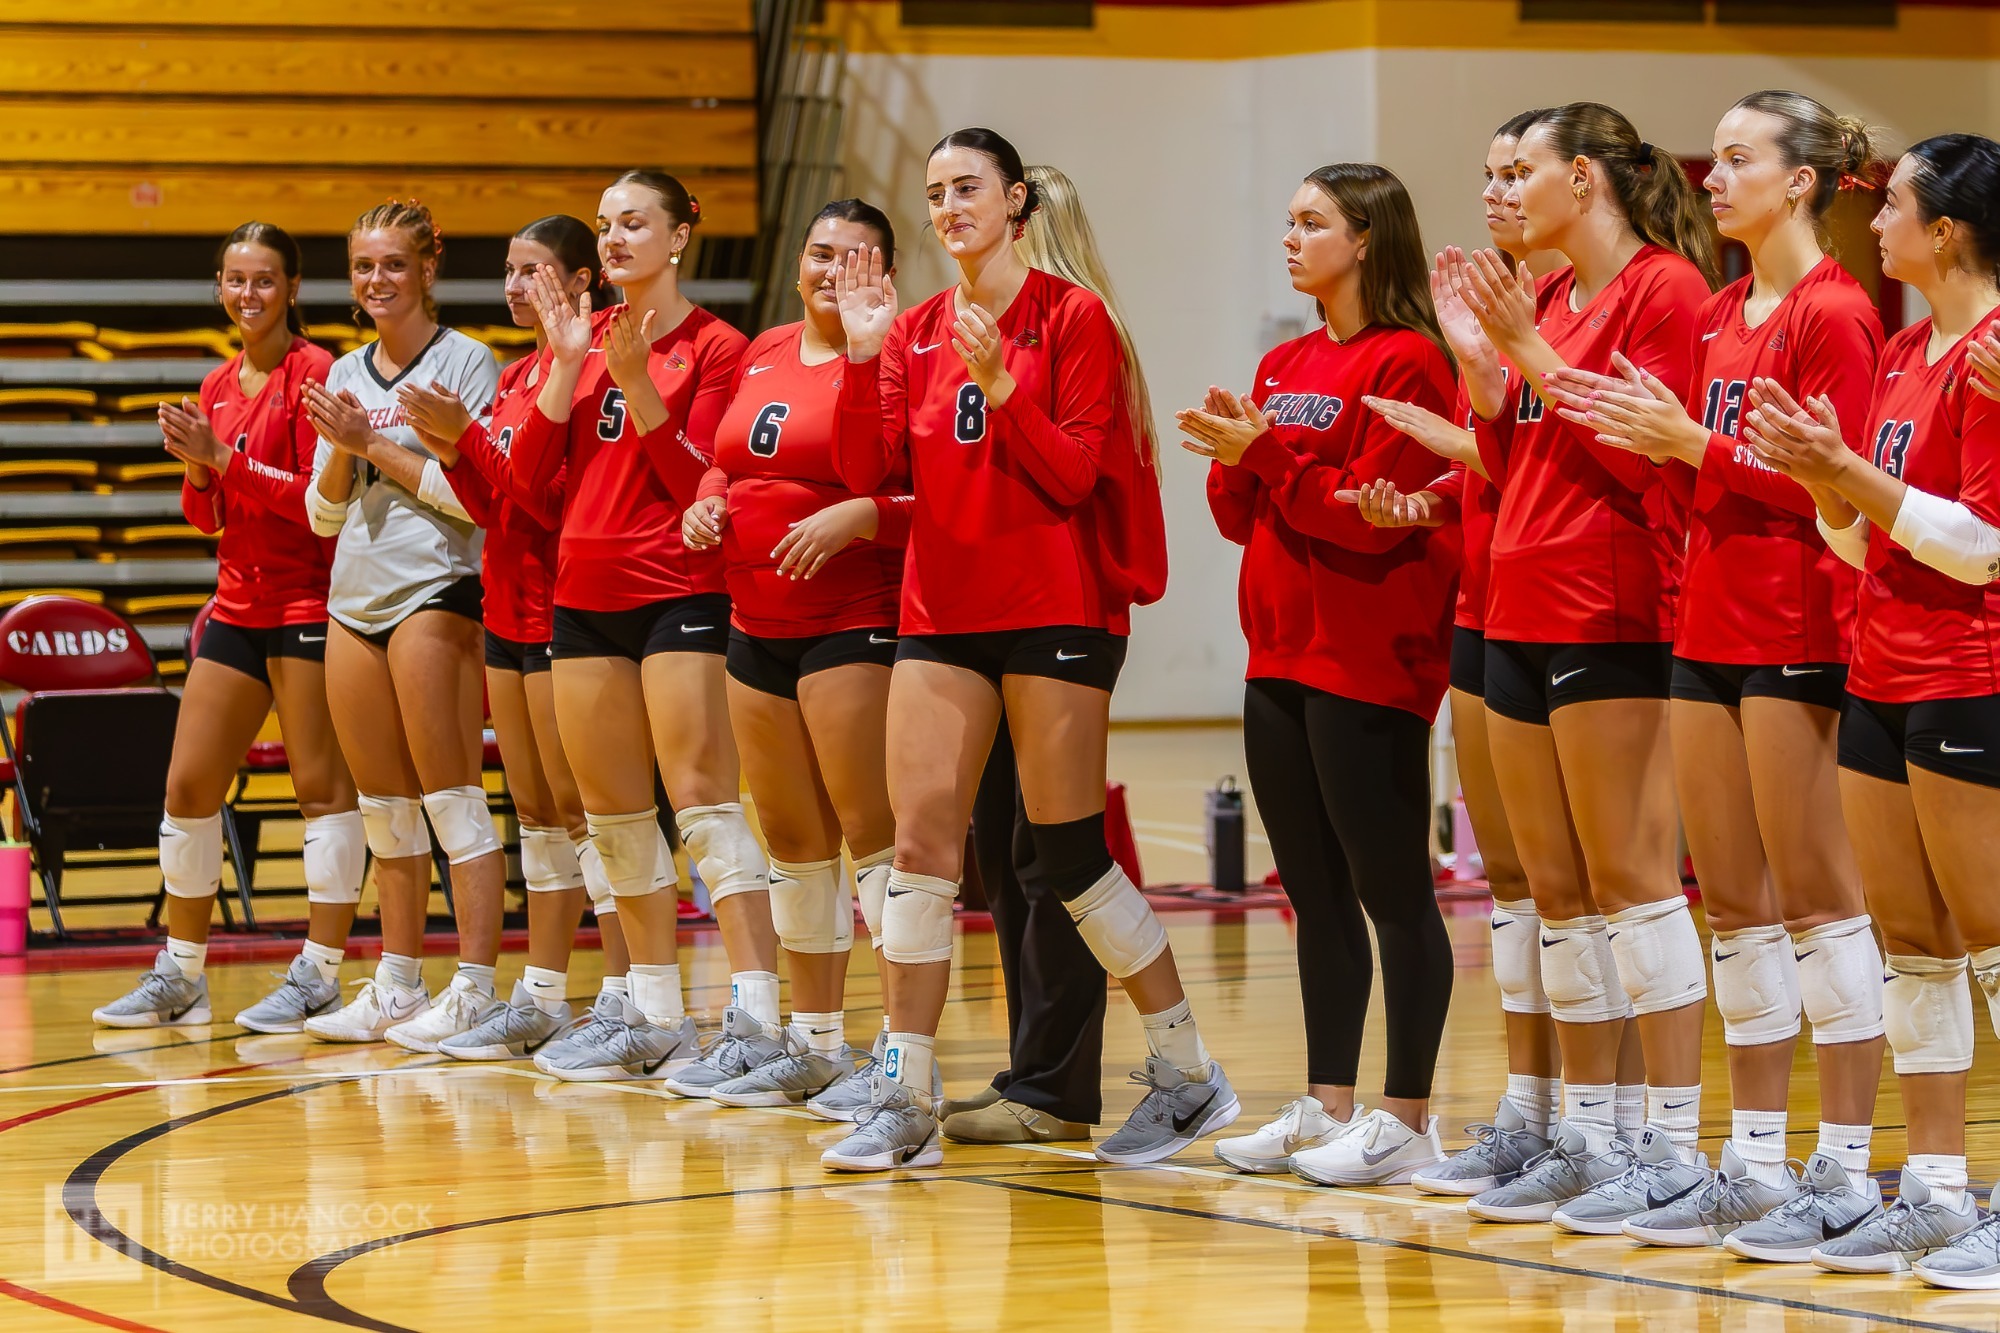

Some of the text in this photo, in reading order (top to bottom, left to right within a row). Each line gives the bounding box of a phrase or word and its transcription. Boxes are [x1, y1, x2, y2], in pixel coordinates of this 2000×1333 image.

[596, 387, 627, 442] 5
[748, 401, 790, 458] 6
[954, 382, 987, 444] 8
[1703, 379, 1747, 440] 12
[1872, 419, 1914, 481] 13
[7, 627, 129, 656] CARDS
